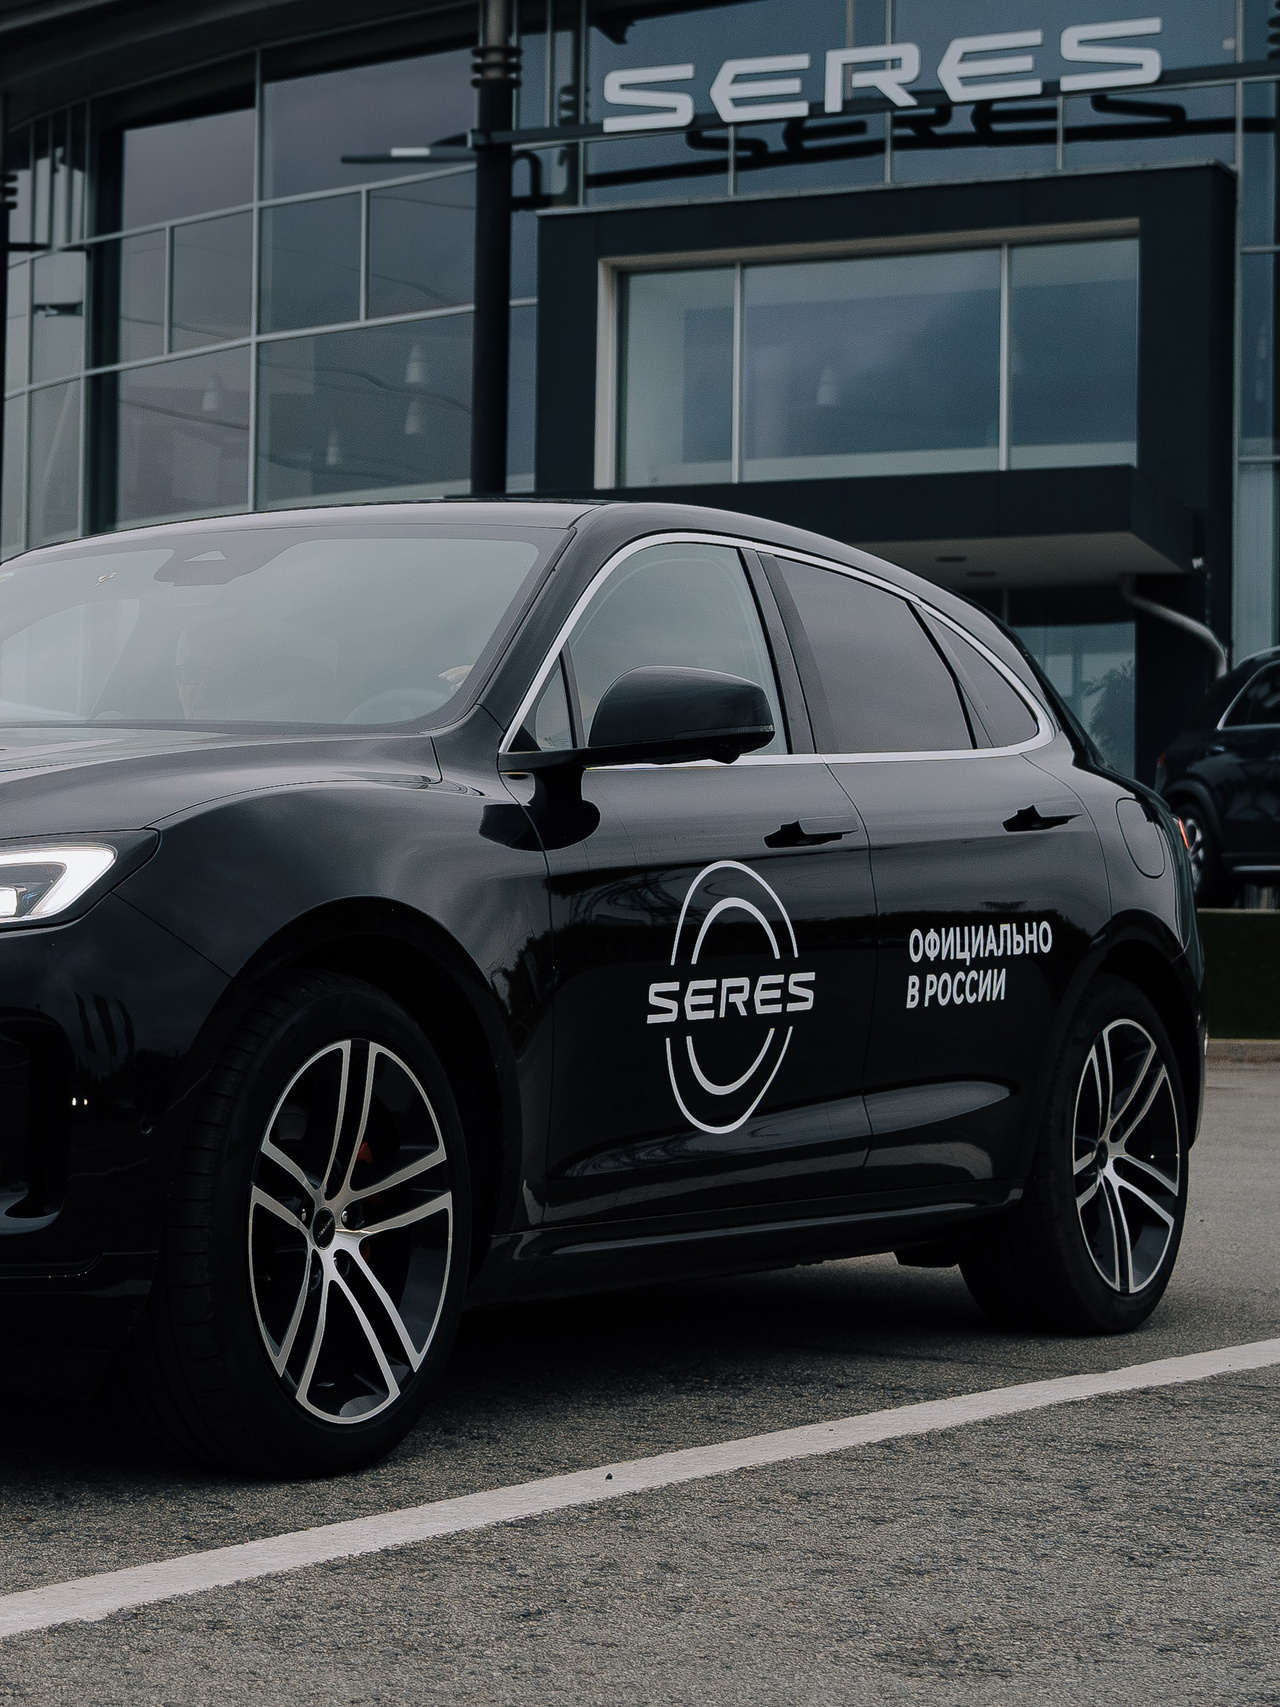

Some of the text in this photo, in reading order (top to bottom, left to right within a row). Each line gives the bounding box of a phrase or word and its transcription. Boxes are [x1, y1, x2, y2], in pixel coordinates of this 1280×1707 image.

[603, 17, 1163, 132] SERES
[909, 921, 1053, 966] ОФИЦИАЛЬНО
[646, 972, 816, 1024] SERES
[906, 968, 1007, 1009] В РОССИИ
